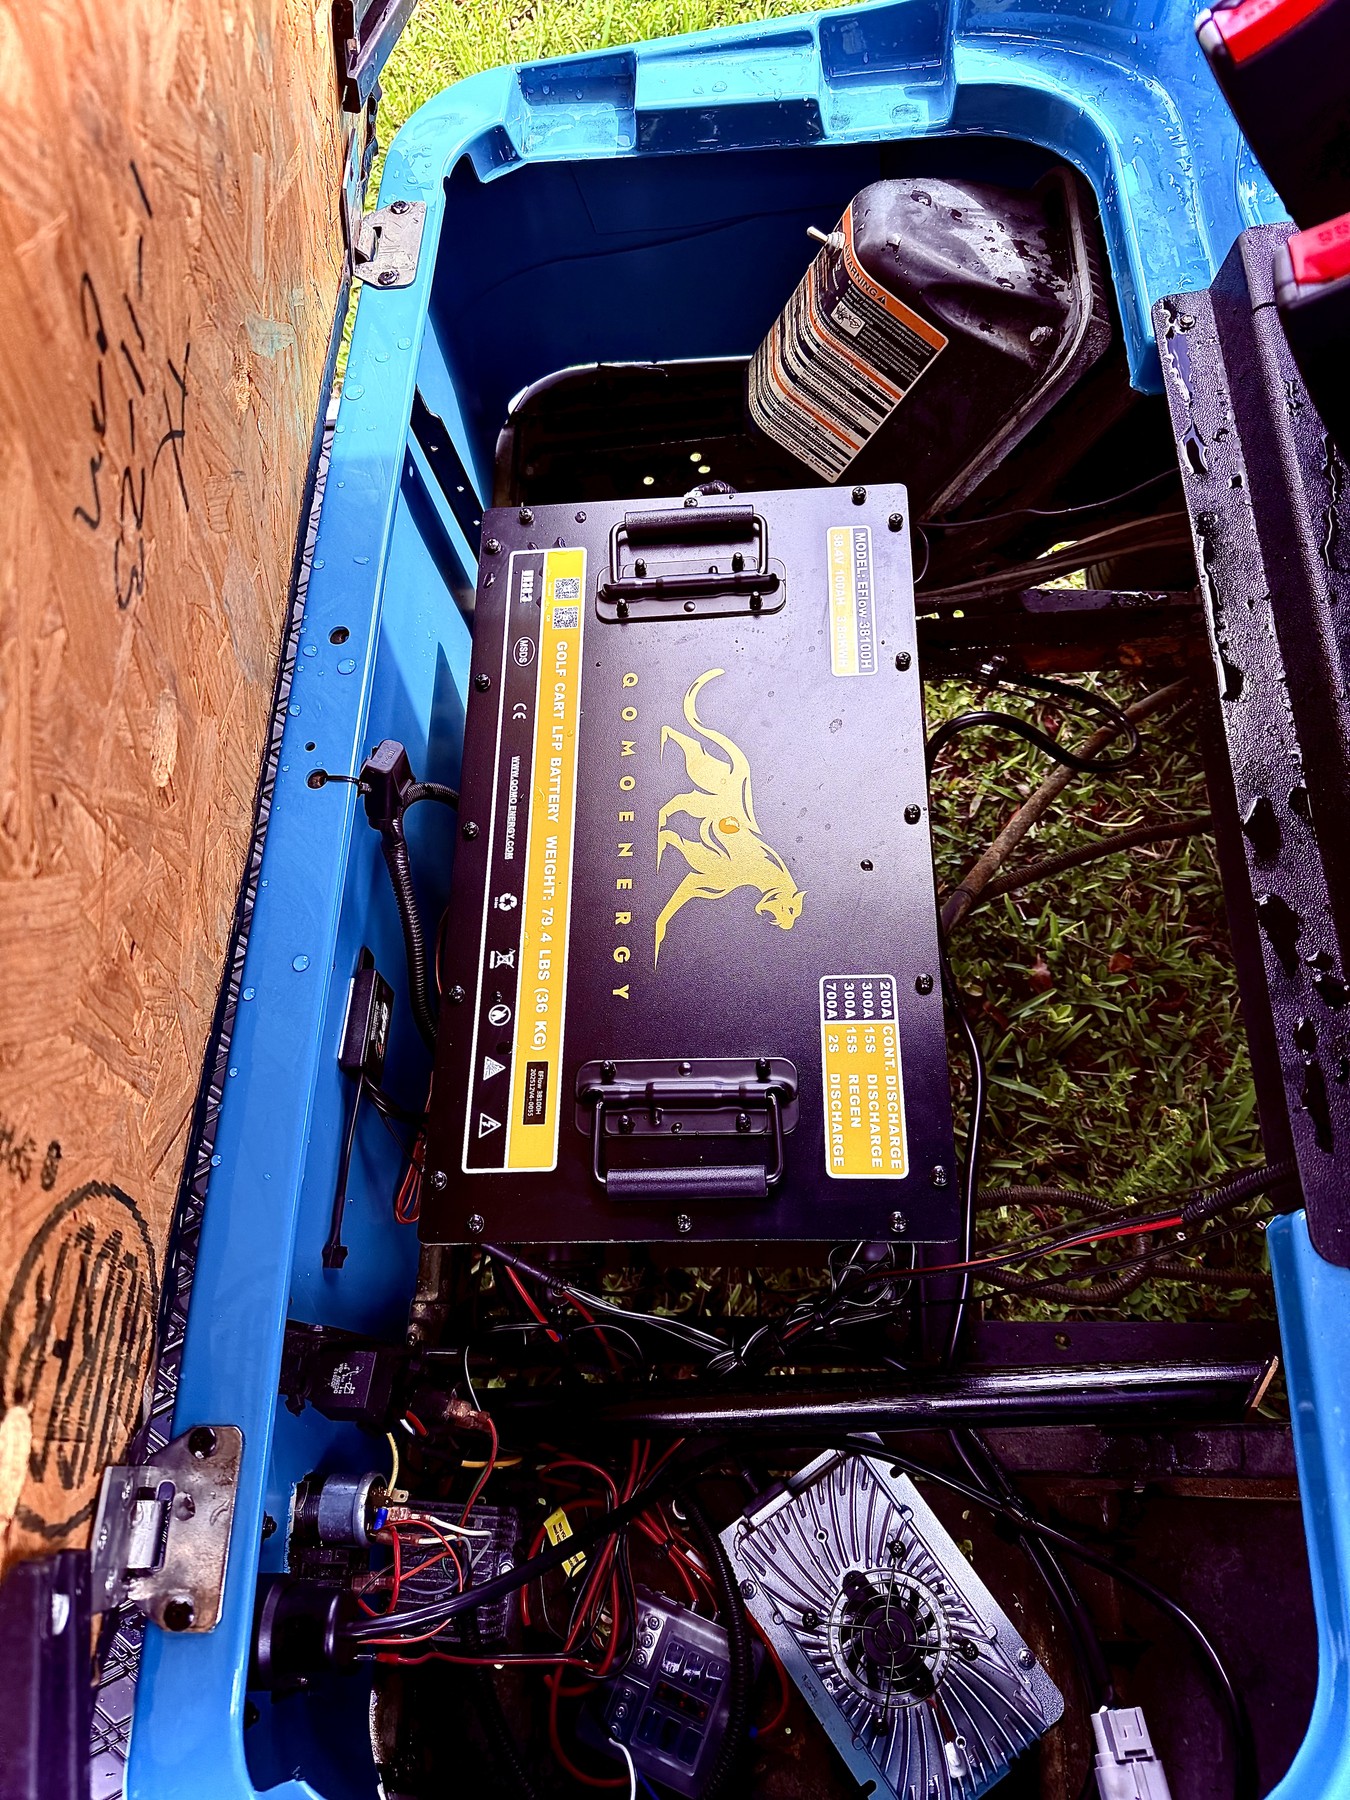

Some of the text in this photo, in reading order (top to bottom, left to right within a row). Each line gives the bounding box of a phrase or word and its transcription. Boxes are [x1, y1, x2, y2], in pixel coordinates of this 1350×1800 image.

[833, 533, 844, 564] 38.4V
[835, 569, 845, 605] 100AH
[854, 532, 872, 669] MODEL: EFlow 38100H
[518, 639, 530, 664] MSDS
[554, 641, 568, 677] GOLF
[552, 682, 566, 720] CART
[550, 725, 564, 751] LFP
[547, 757, 562, 823] BATTERY
[542, 835, 558, 901] WEIGHT:
[538, 949, 552, 981] LBS
[533, 987, 549, 1013] (36
[530, 1020, 547, 1051] KG)
[844, 982, 862, 1128] 300A 15S REGEN
[826, 983, 845, 1167] 700A 2S DISCHARGE
[862, 982, 883, 1168] 300A 15S DISCHARGE
[880, 981, 902, 1169] 200A CONT. DISCHARGE
